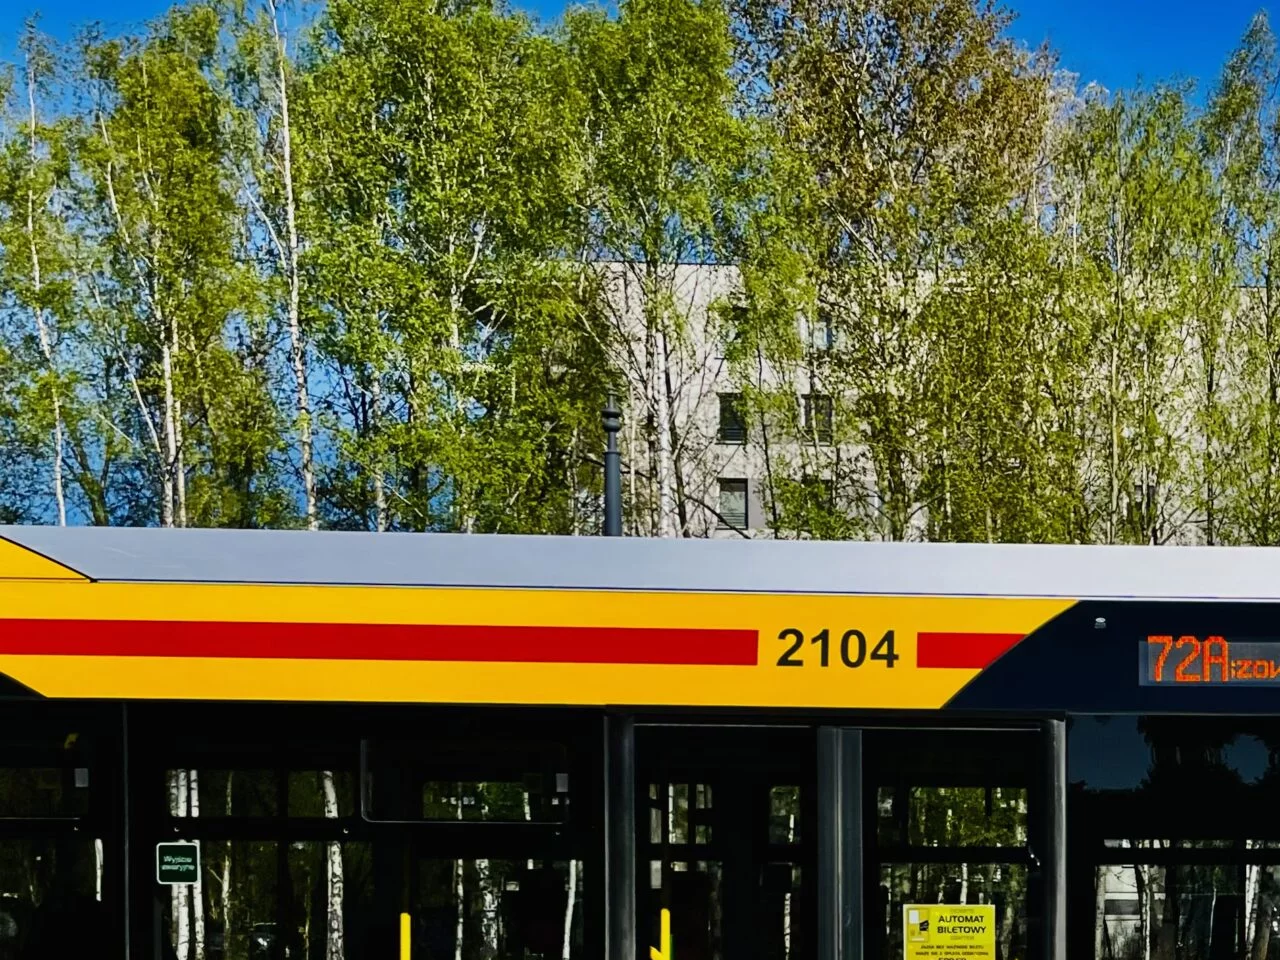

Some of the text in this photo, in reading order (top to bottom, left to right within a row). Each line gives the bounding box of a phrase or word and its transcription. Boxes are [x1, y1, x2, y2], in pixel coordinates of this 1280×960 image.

[776, 628, 900, 669] 2104
[1147, 635, 1229, 682] 72A
[937, 926, 986, 934] BILETOWY
[938, 915, 984, 923] AUTOMAT
